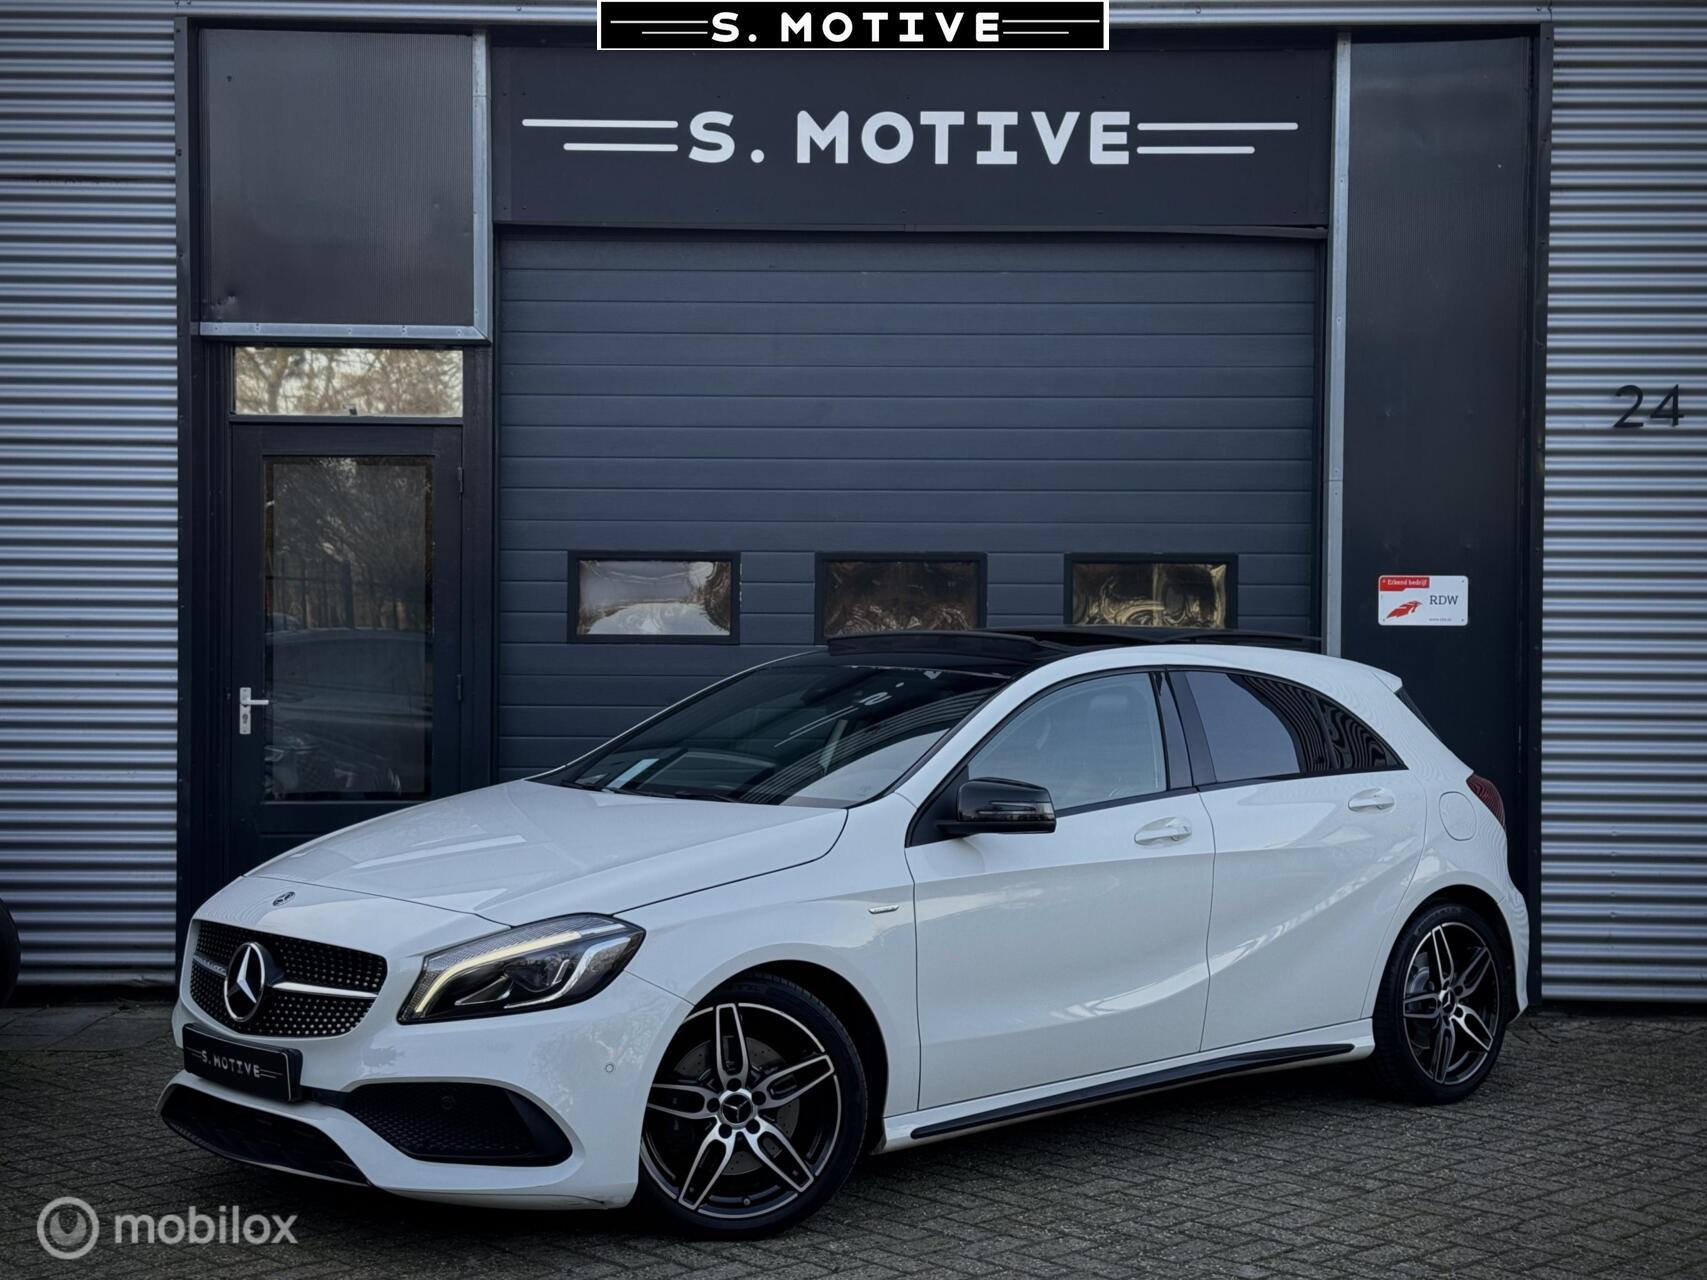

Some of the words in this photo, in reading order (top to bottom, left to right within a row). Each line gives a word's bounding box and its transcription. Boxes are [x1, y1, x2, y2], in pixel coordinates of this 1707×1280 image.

[688, 110, 765, 164] S.
[796, 110, 1131, 165] MOTIVE
[1613, 384, 1685, 428] 24
[1429, 594, 1459, 606] RDW
[201, 1050, 212, 1065] S.
[213, 1055, 260, 1078] MOTIVE
